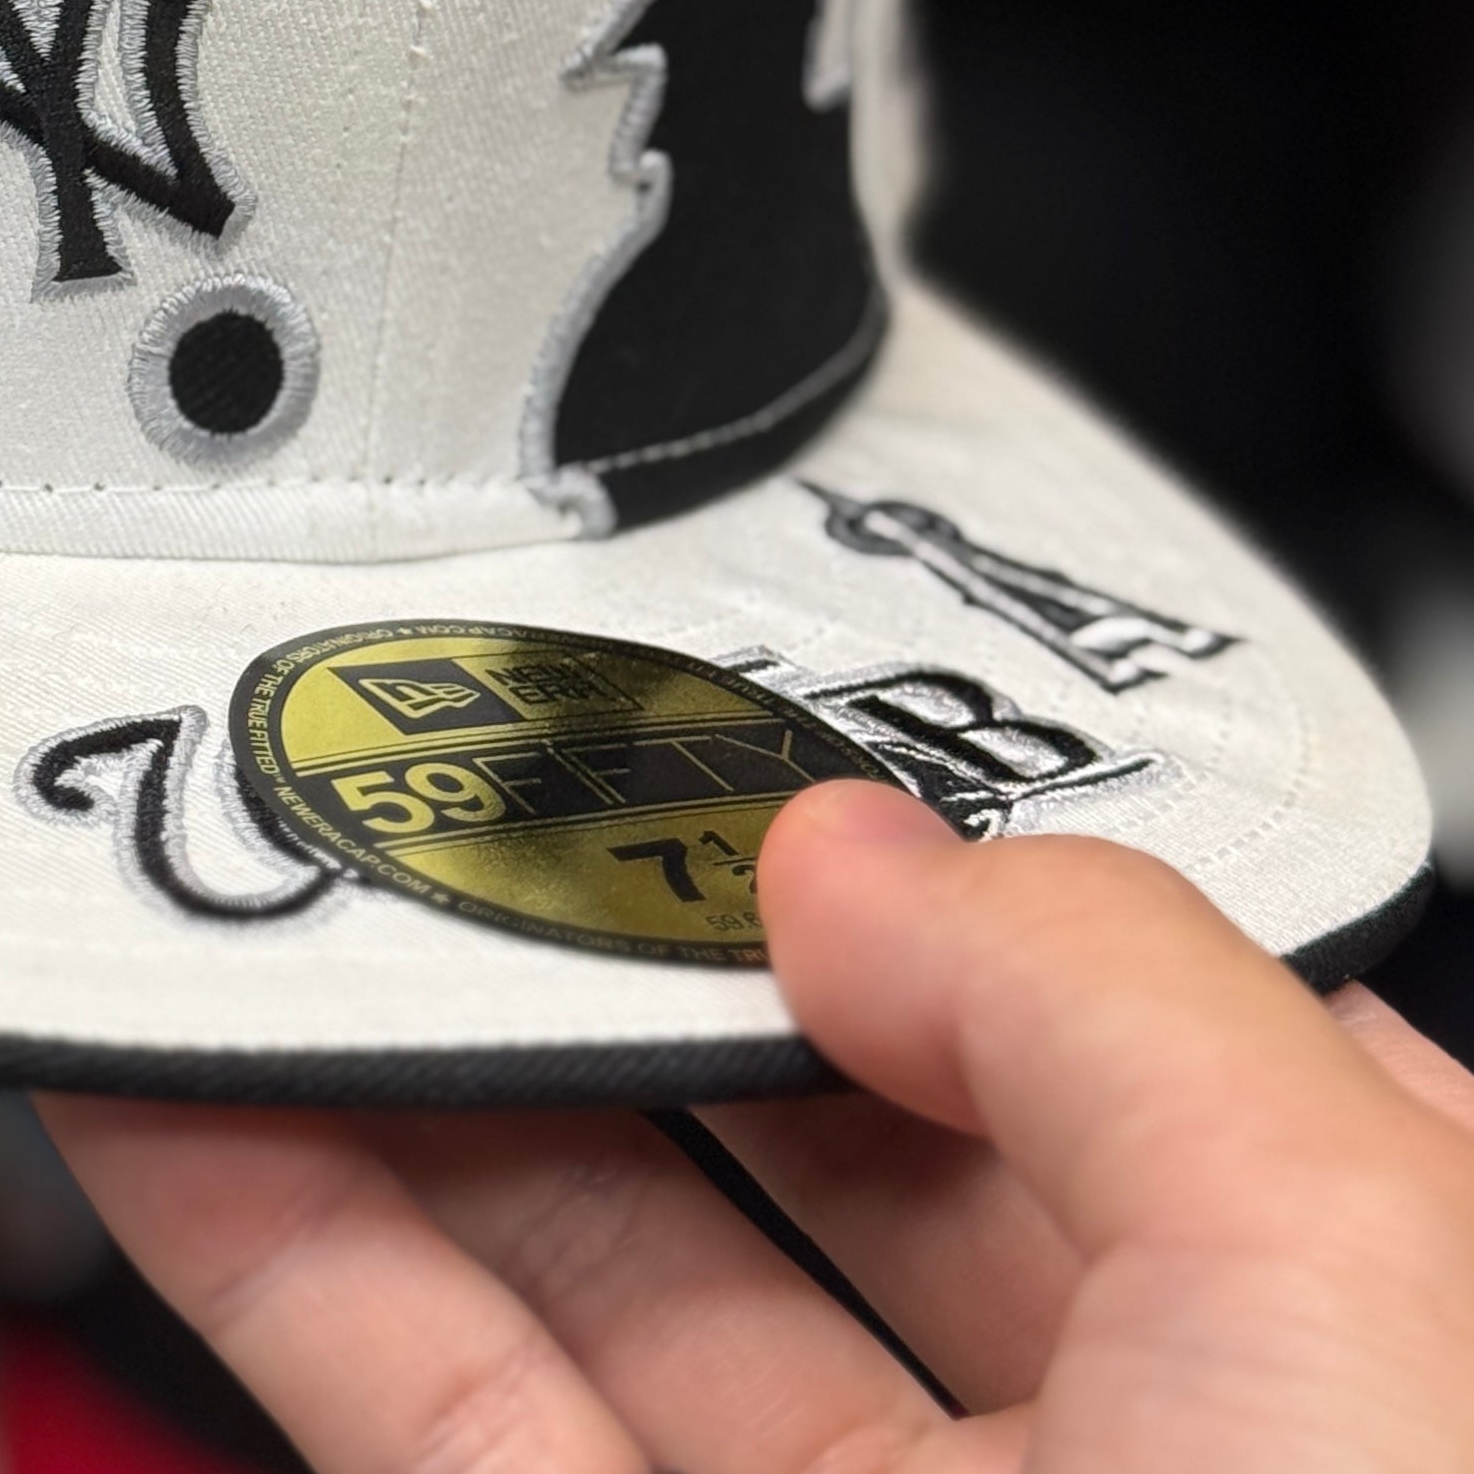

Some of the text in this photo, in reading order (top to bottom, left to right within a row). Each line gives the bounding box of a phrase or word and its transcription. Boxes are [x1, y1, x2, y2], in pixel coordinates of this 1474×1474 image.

[247, 697, 272, 729] TRUE
[252, 672, 284, 700] THE
[330, 728, 818, 835] 59FIFTY
[274, 785, 435, 895] NEWERACAP.COM
